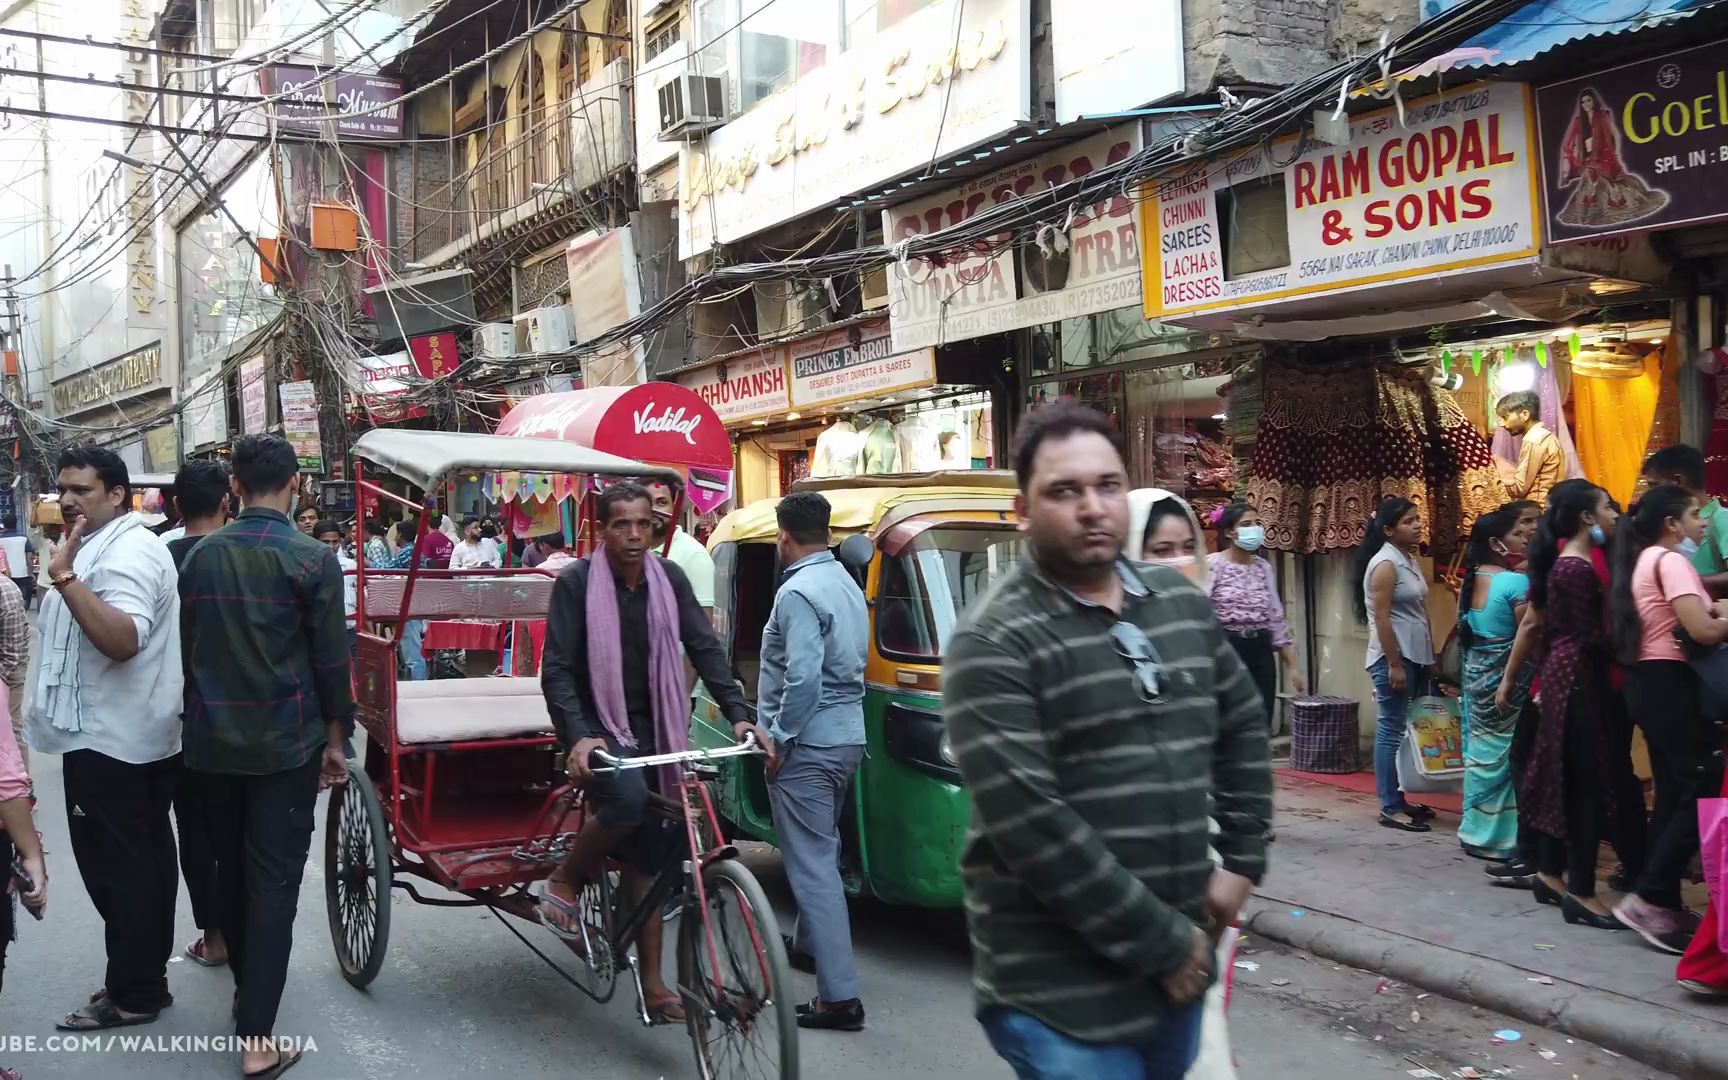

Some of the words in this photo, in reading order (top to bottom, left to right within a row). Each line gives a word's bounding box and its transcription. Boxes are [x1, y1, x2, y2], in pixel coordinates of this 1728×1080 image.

[1294, 146, 1370, 209] RAM
[1379, 113, 1515, 187] GOPAL
[1688, 150, 1706, 168] IN
[1160, 170, 1208, 203] LEHNGA
[1163, 198, 1206, 228] CHUNNI
[1322, 209, 1353, 246] &
[1364, 179, 1493, 238] SONS
[1162, 223, 1212, 253] SAREES
[1164, 252, 1208, 280] LACHA
[1210, 251, 1218, 268] &
[1299, 258, 1327, 278] 5564
[1327, 255, 1344, 274] NAI
[1164, 276, 1221, 305] DRESSES
[796, 350, 840, 377] PRINCE
[886, 358, 912, 374] SAREES
[633, 402, 702, 445] Vadilal
